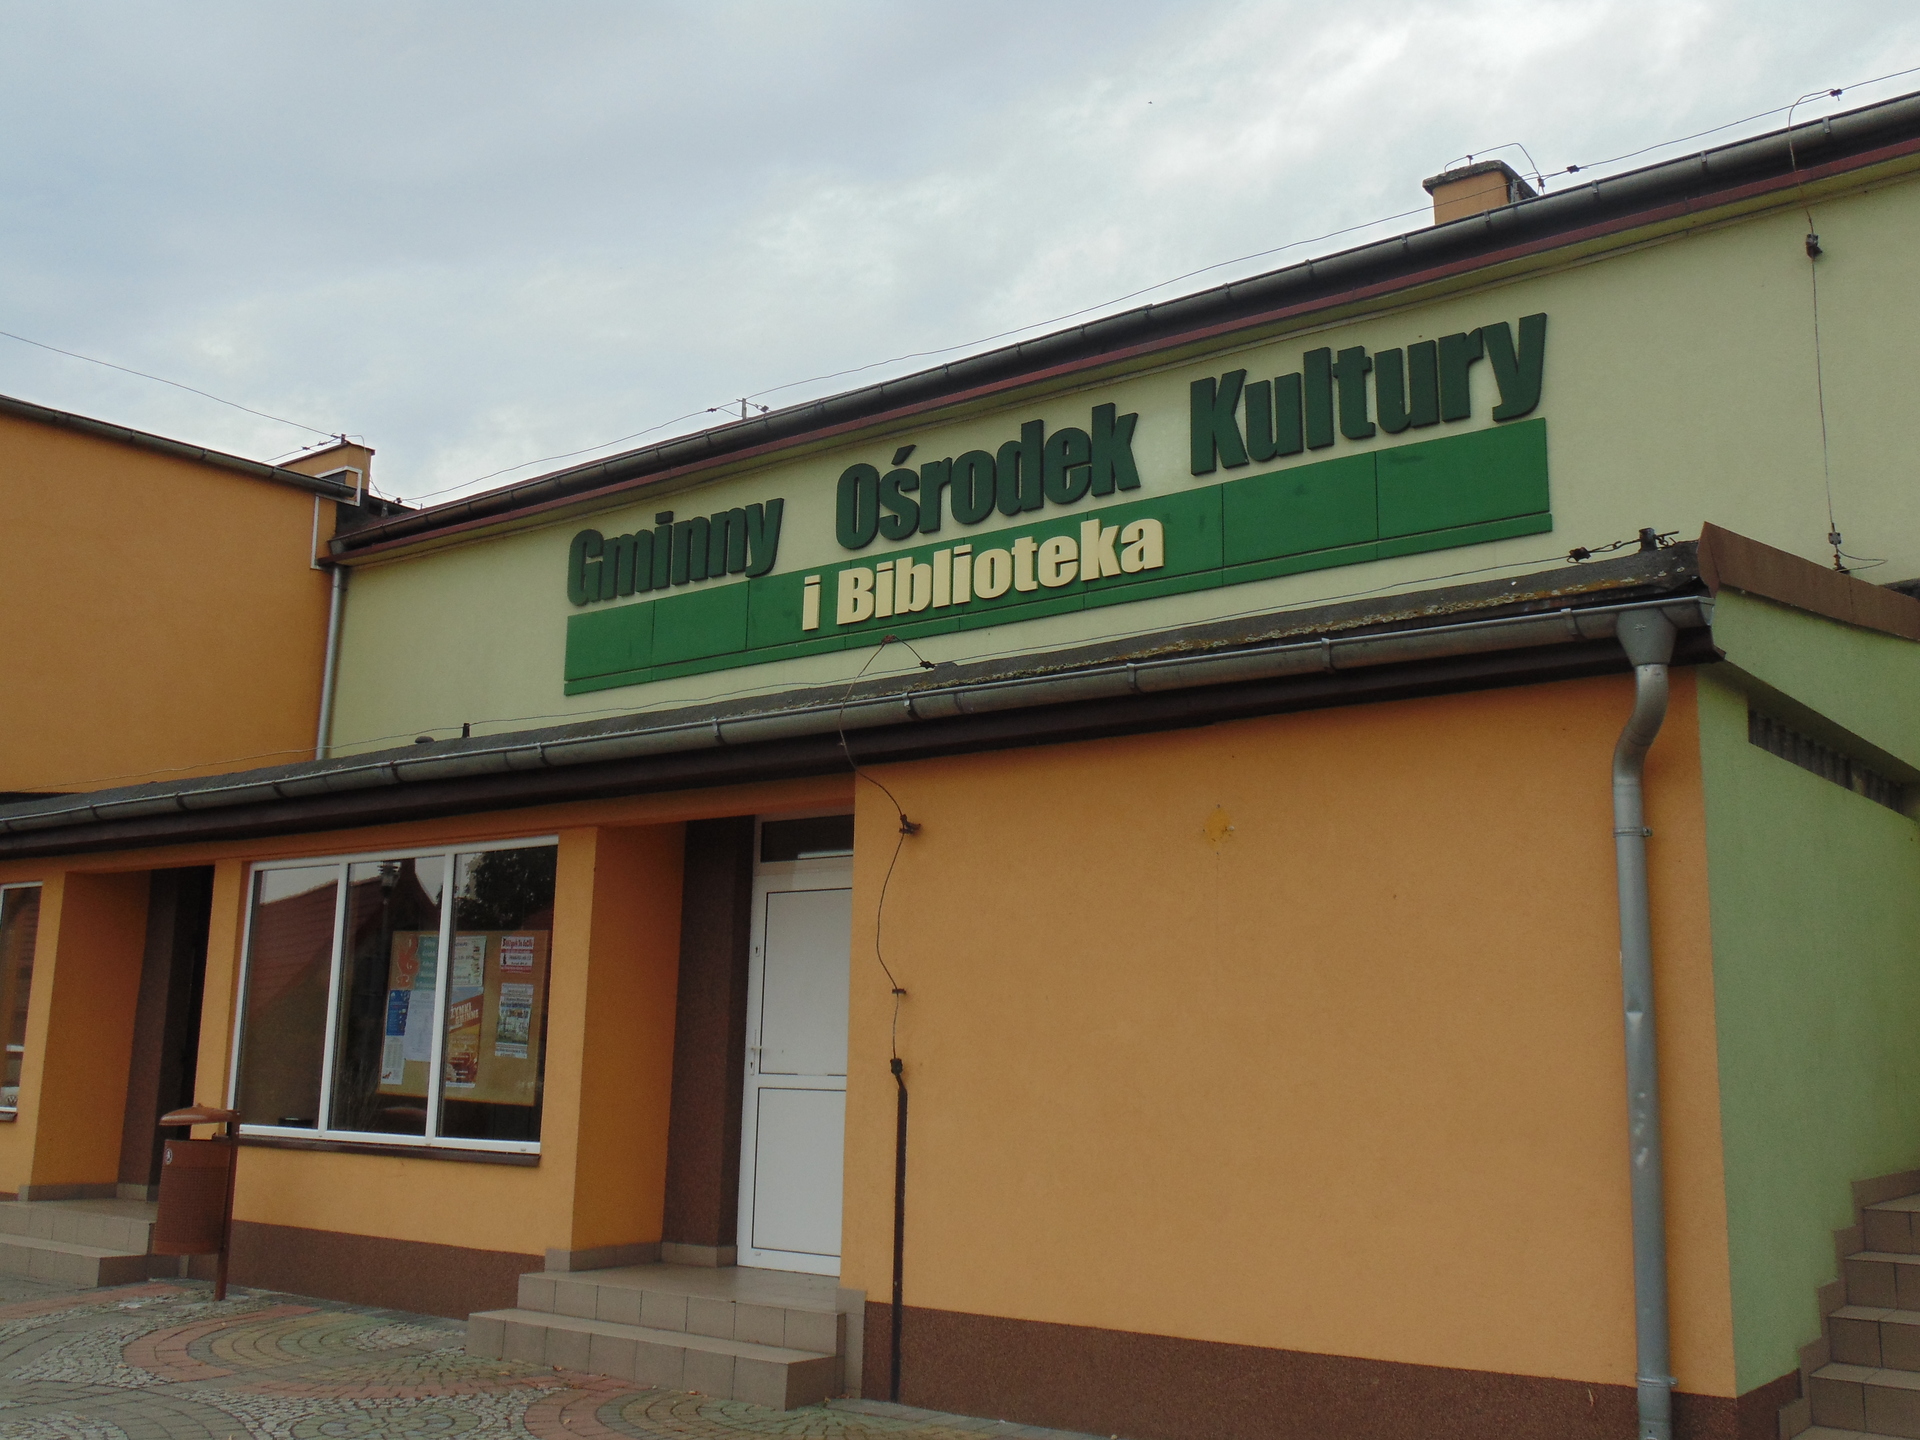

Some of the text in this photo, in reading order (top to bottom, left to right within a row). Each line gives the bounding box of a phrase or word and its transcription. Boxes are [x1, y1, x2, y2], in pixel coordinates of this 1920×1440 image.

[567, 312, 1547, 606] Gminny Ośrodek Kultury
[802, 517, 1165, 631] i Biblioteka
